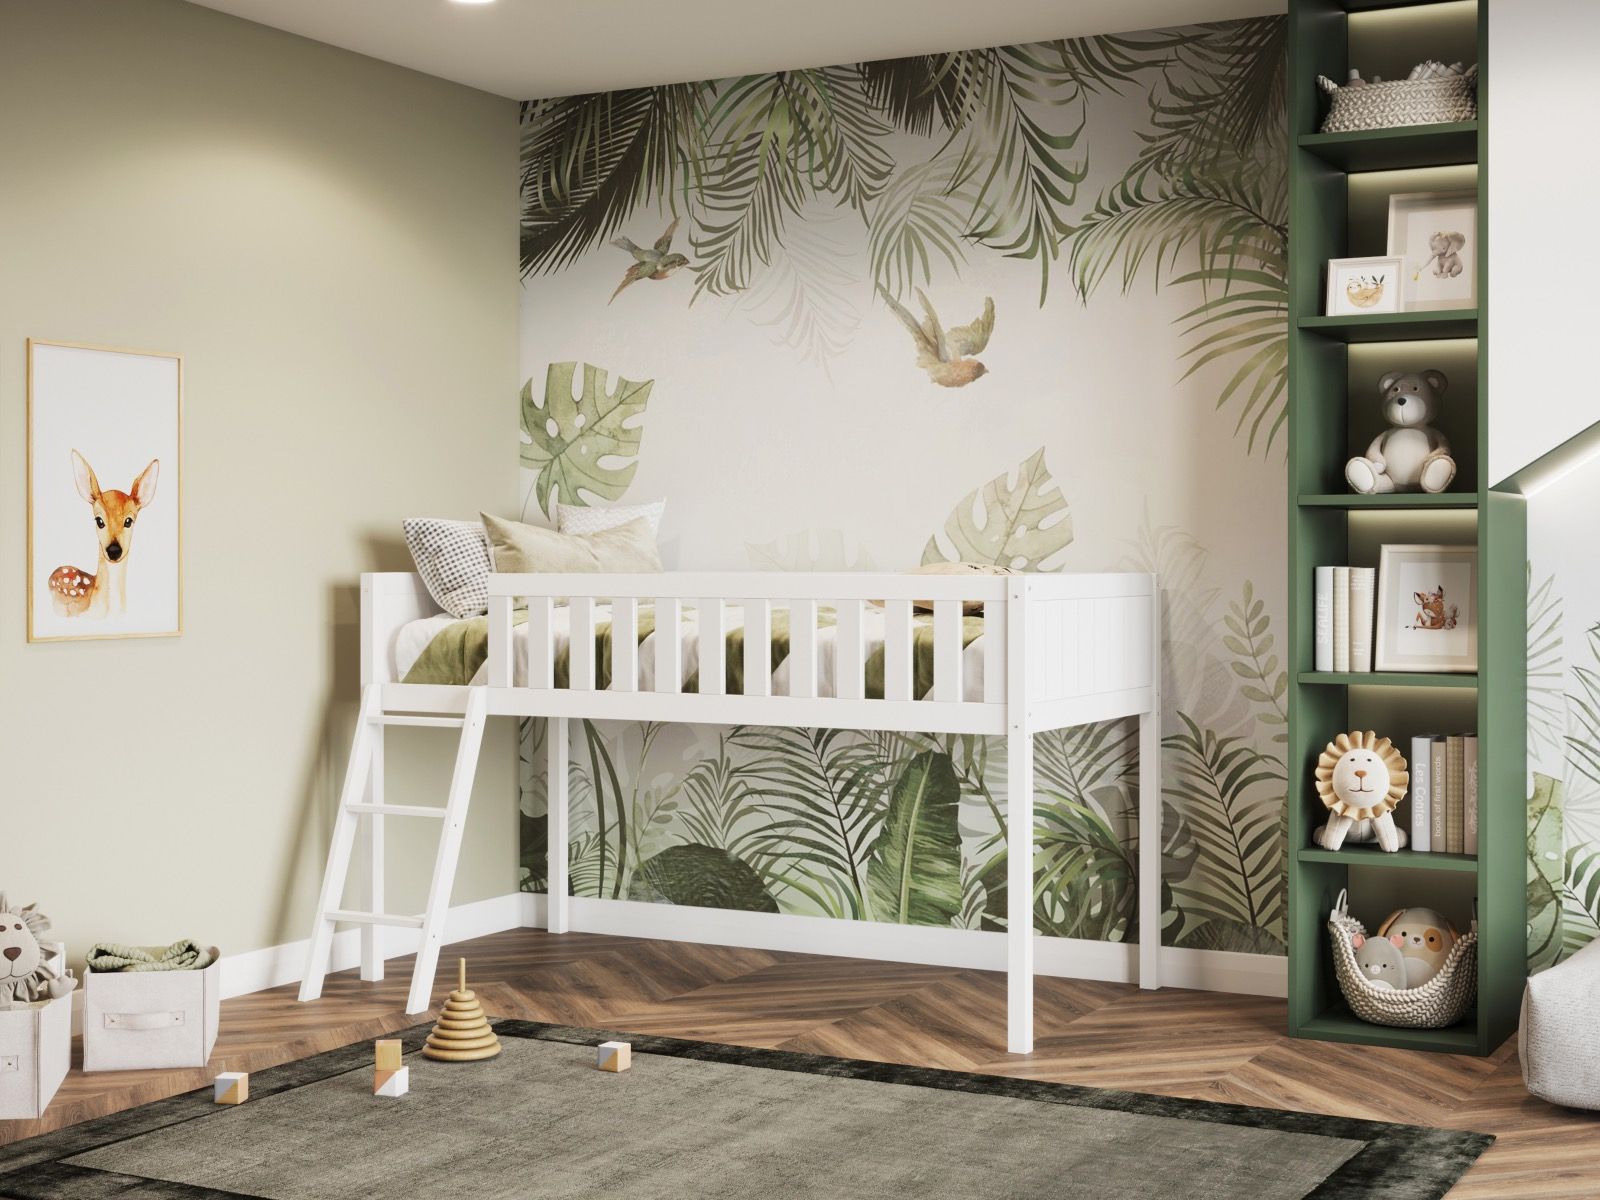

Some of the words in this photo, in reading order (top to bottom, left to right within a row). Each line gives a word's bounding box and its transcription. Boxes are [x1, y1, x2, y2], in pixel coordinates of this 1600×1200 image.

[1415, 763, 1426, 783] Les
[1415, 786, 1426, 827] Contes
[1434, 803, 1441, 813] of
